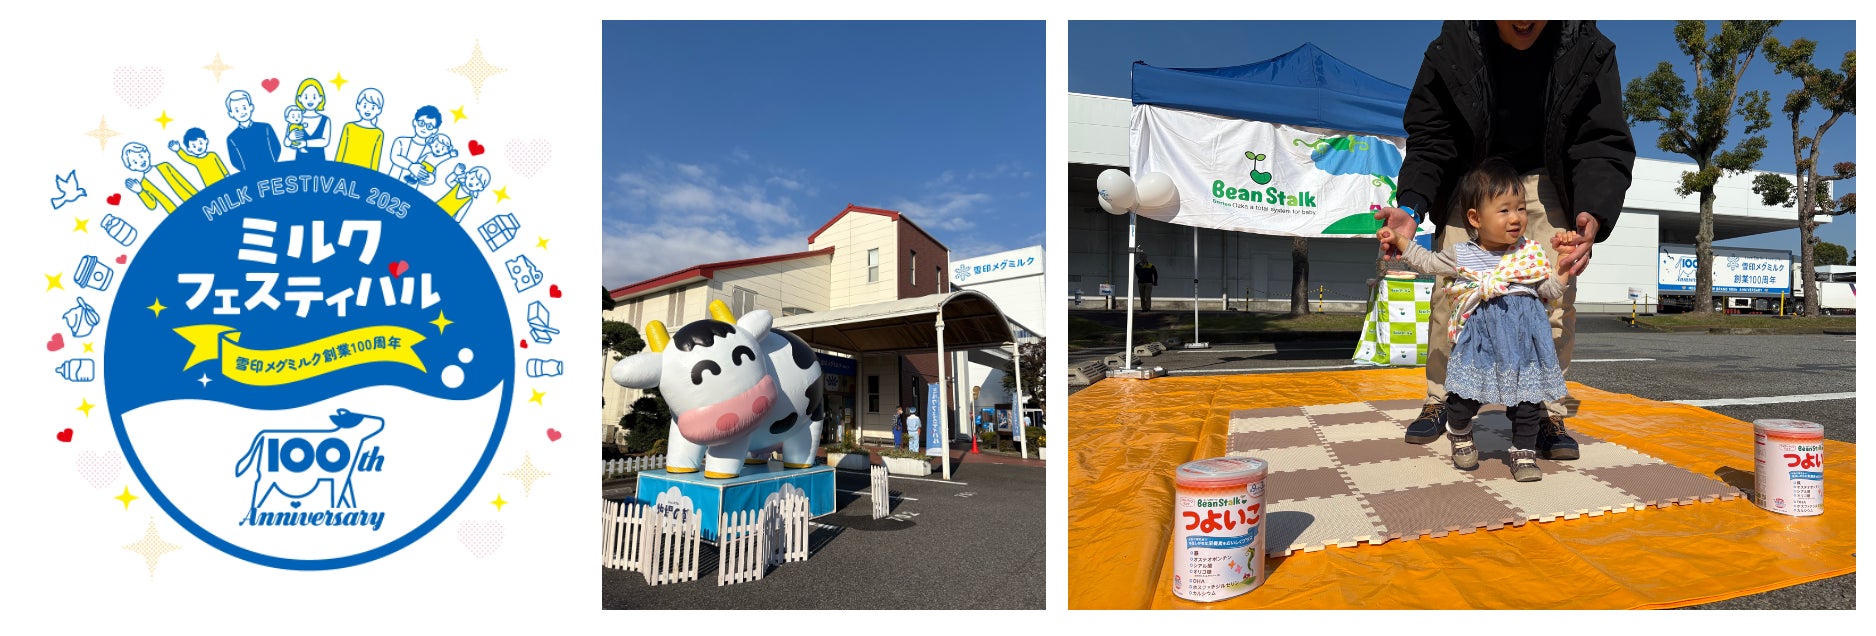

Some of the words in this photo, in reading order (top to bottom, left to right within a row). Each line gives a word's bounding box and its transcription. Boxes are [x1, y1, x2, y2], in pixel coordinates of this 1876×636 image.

[202, 185, 252, 222] MILK
[257, 175, 361, 199] FESTIVAL
[365, 187, 411, 219] 2025
[1212, 179, 1263, 203] Bean
[1265, 186, 1317, 208] Stalk
[237, 217, 382, 265] ミルク
[973, 257, 1035, 275] 雪印メグミルク
[1733, 274, 1777, 285] 創業100周年
[1741, 262, 1785, 272] 雪印メグミルク
[177, 270, 442, 319] フェスティバル
[235, 335, 402, 374] 雪印メグミルク創業100周年
[238, 507, 386, 531] Anniversary
[1182, 503, 1261, 534] つよいこ
